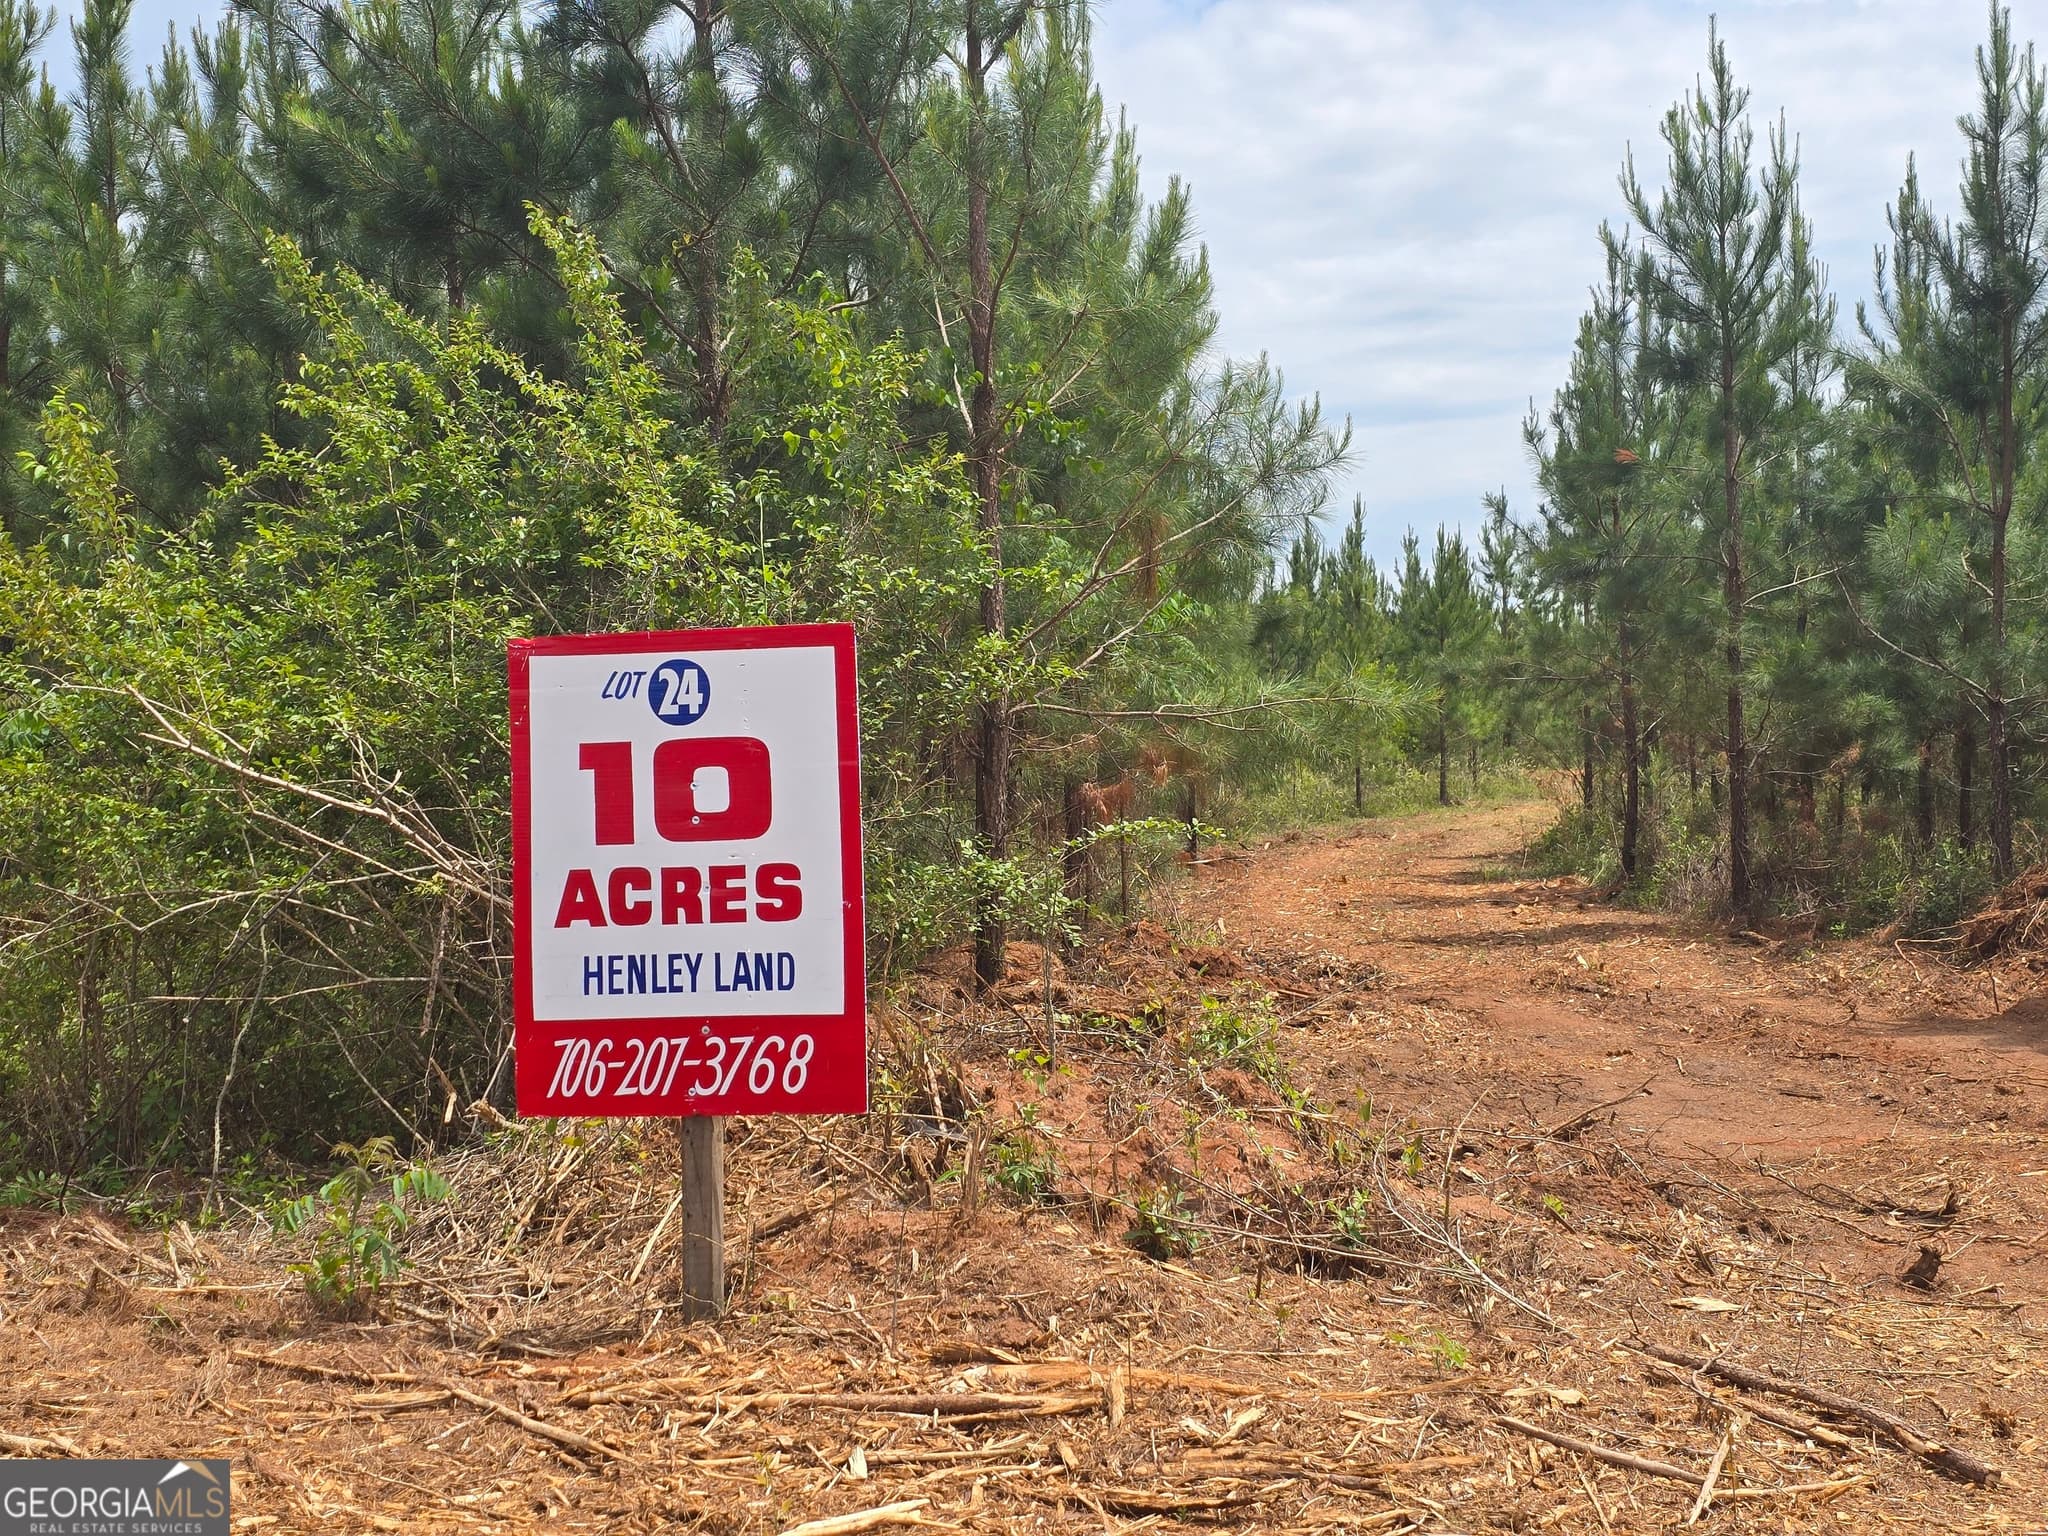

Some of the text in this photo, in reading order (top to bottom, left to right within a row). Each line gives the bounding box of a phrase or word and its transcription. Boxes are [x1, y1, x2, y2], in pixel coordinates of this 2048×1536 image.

[601, 668, 703, 716] LOT 24
[578, 736, 772, 846] 10
[554, 862, 803, 929] ACRES
[583, 951, 796, 996] HENLEY LAND
[546, 1034, 815, 1099] 706-207-3768
